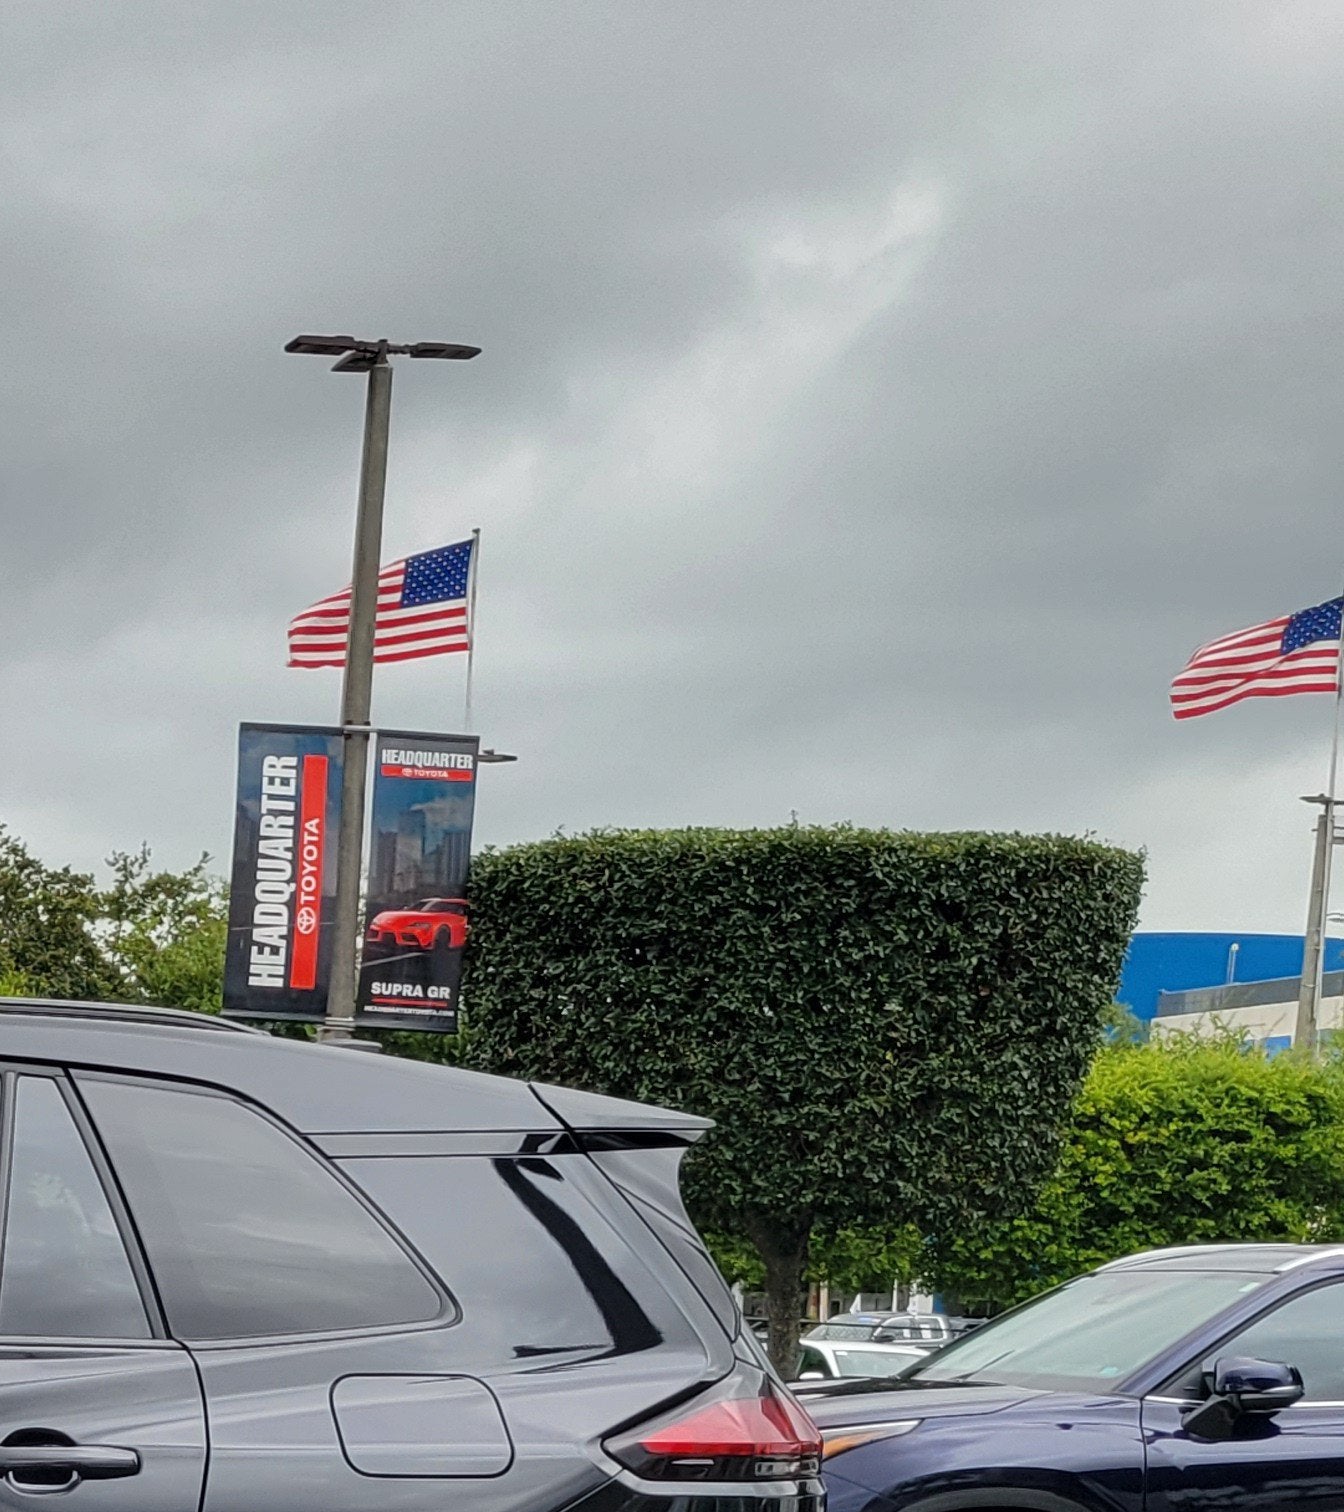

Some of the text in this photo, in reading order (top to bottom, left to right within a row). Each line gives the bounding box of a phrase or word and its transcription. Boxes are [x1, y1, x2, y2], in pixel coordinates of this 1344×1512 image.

[382, 749, 474, 770] HEADQUARTER
[414, 768, 449, 778] TOYOTA
[248, 755, 299, 988] HEADQUARTER
[300, 818, 320, 905] TOYOTA
[371, 982, 451, 999] SUPRA GR
